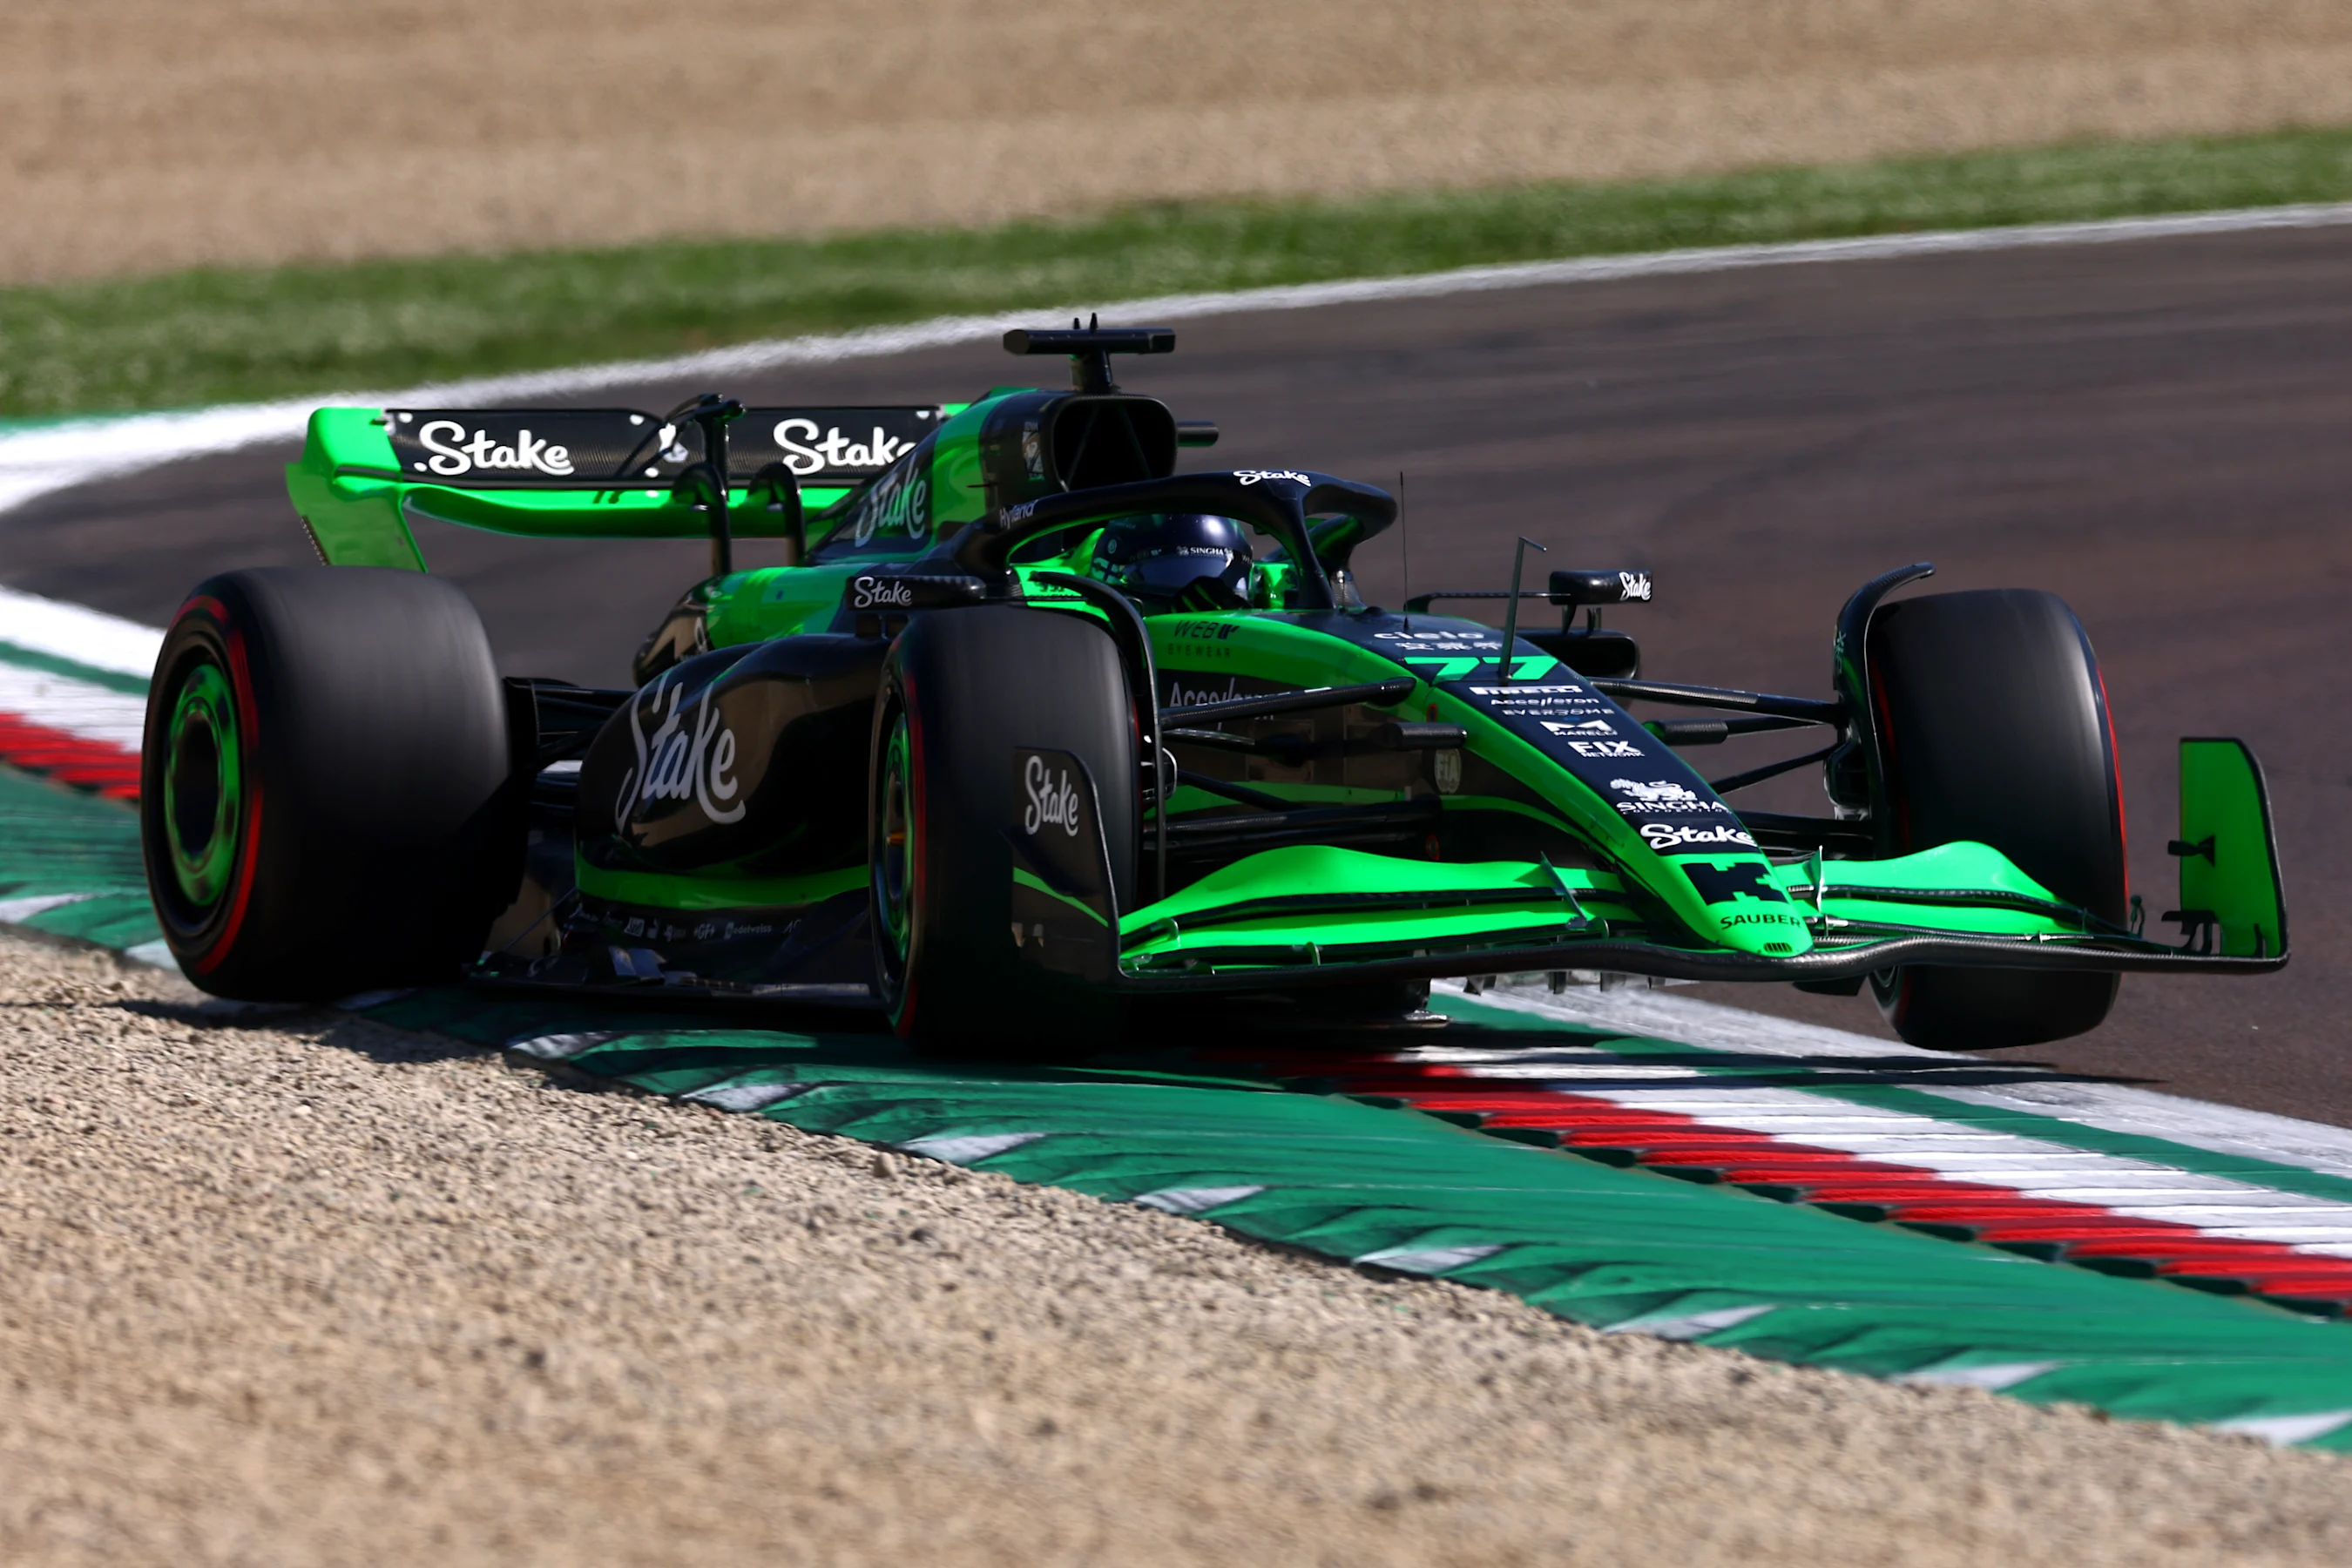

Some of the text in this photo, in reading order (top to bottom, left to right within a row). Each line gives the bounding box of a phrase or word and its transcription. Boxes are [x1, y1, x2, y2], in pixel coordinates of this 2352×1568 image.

[419, 420, 575, 476] Stake
[1233, 470, 1312, 486] Stake
[855, 452, 927, 548] Stake
[1190, 546, 1224, 556] SINGHA
[854, 576, 913, 609] Stake
[1619, 571, 1652, 602] Stake
[1173, 619, 1220, 639] WEB
[1374, 631, 1484, 639] cielo
[1167, 643, 1231, 658] EYEWEAR
[1403, 655, 1559, 686] 77
[614, 669, 747, 835] Stake
[1567, 740, 1643, 754] FIX
[1024, 755, 1079, 837] Stake
[1616, 801, 1733, 814] SINGHA
[1639, 823, 1758, 850] Stake
[1720, 914, 1801, 930] SAUBER
